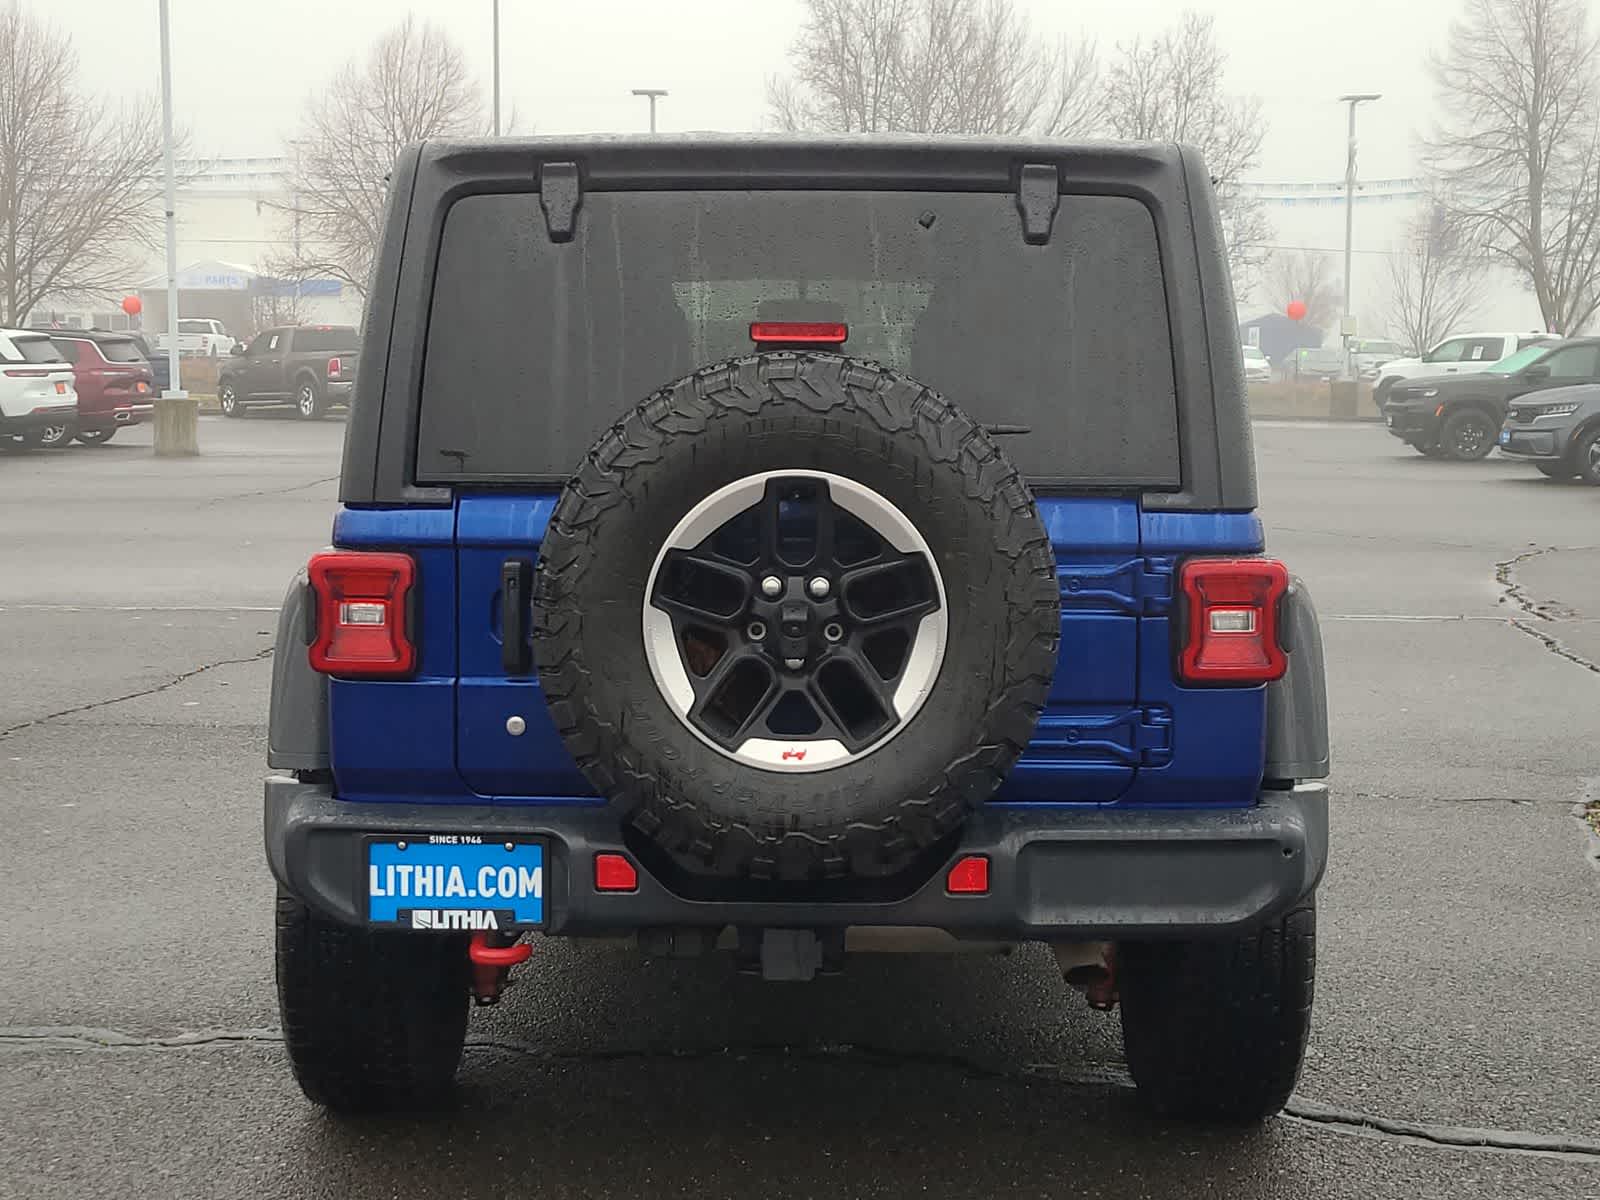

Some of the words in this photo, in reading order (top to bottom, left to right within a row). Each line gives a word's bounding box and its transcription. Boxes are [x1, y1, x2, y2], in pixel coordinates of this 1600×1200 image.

[429, 835, 458, 844] SINCE
[461, 835, 482, 844] 1946
[369, 864, 543, 898] LITHIA.COM
[432, 910, 498, 930] LITHIA
